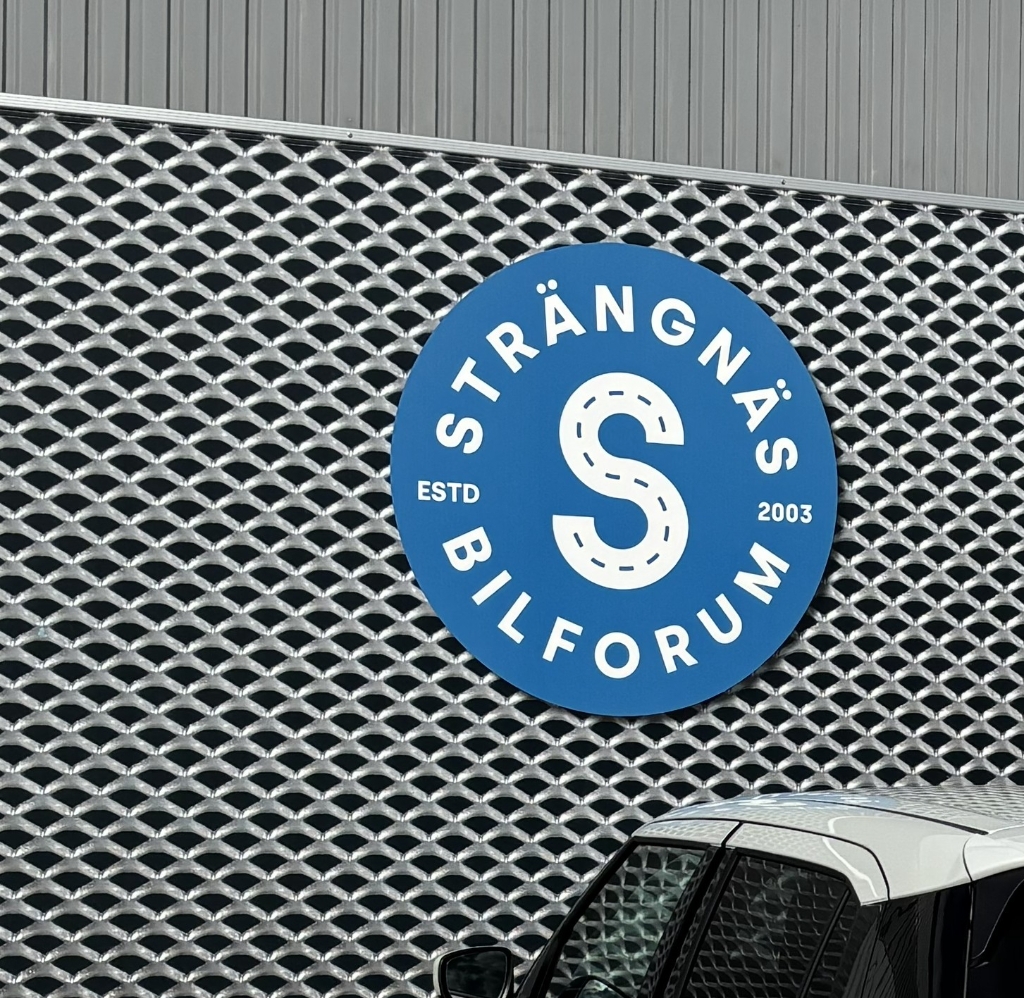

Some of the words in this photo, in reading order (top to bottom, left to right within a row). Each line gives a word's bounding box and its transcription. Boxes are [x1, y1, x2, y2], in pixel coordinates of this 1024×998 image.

[435, 279, 799, 475] STRÄNGNÄS
[417, 480, 480, 504] ESTD
[552, 372, 690, 590] S
[757, 501, 813, 524] 2003
[442, 526, 790, 679] BILFORUM
